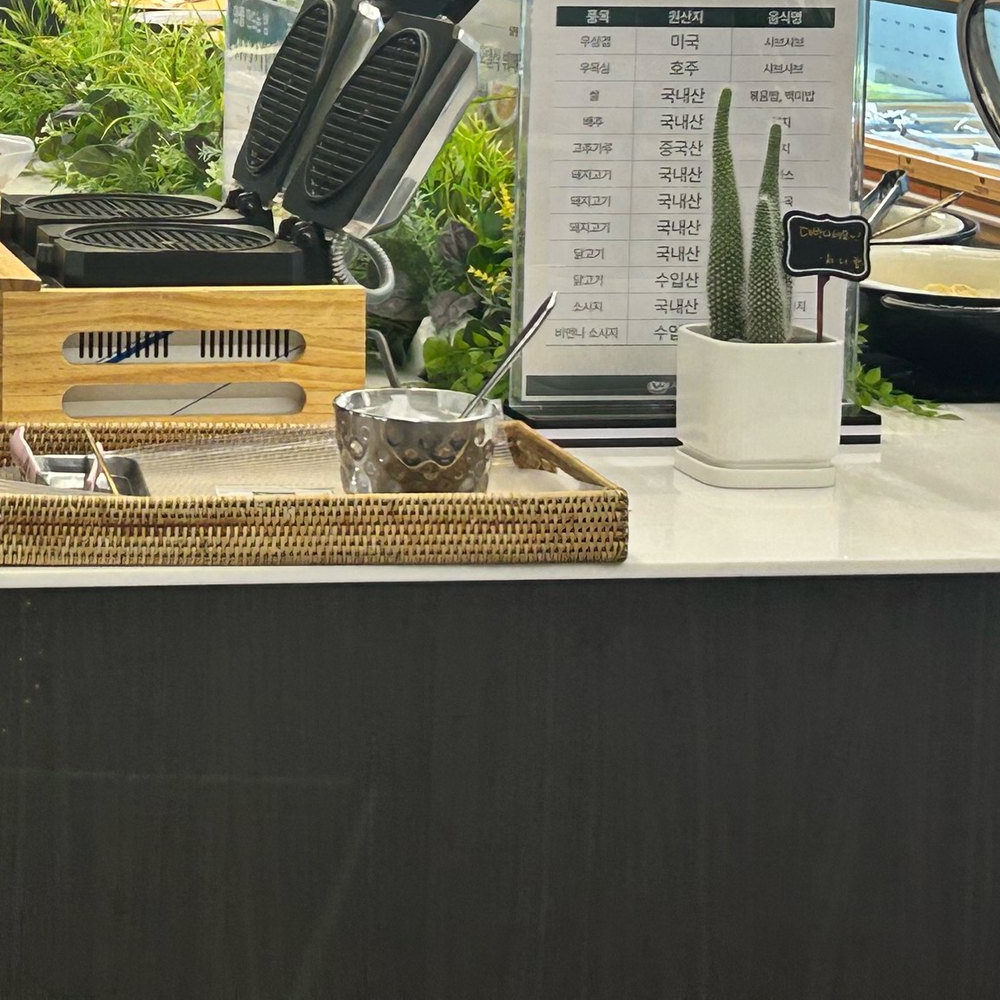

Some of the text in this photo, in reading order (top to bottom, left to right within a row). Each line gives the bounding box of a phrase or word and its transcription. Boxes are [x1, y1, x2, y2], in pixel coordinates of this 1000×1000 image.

[668, 10, 704, 25] 원산지
[671, 34, 700, 50] 미국
[669, 60, 699, 76] 호주
[661, 87, 705, 104] 국내산
[660, 113, 703, 130] 국내산
[658, 166, 702, 183] 국내산
[657, 192, 701, 209] 국내산
[657, 219, 701, 236] 국내산
[656, 245, 699, 262] 국내산
[655, 272, 699, 288] 수입산
[572, 301, 603, 312] 소시지
[654, 298, 698, 315] 국내산
